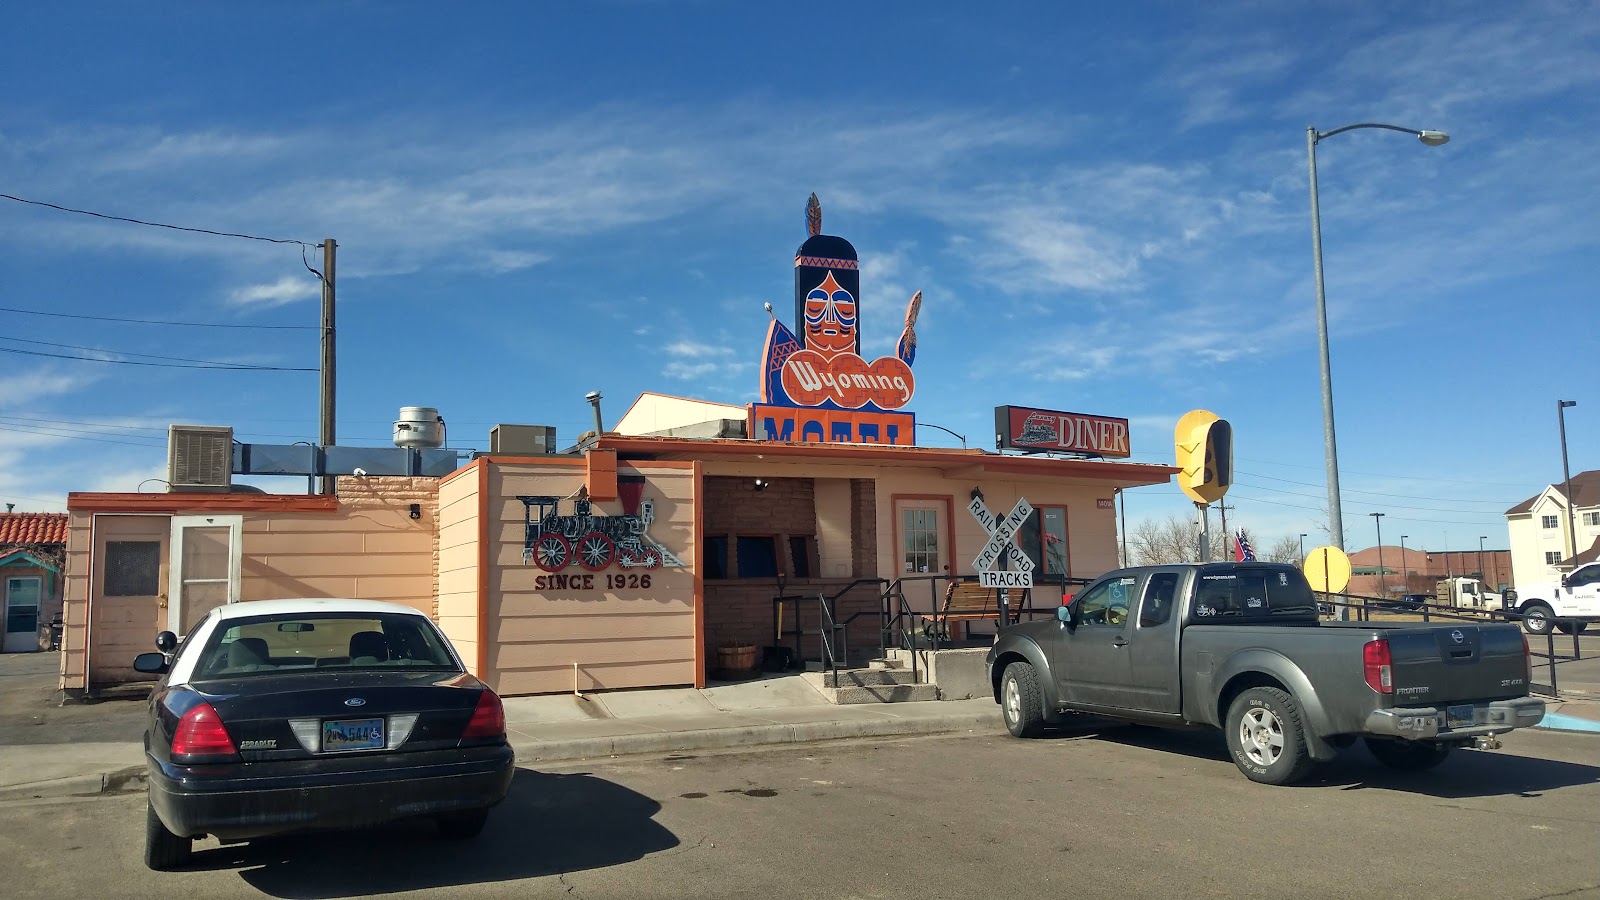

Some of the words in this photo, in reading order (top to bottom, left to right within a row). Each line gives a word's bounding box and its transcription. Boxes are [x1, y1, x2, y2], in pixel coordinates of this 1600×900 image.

[788, 360, 910, 402] Wyoming
[1057, 415, 1128, 453] DINER
[970, 501, 994, 532] RAIL
[978, 505, 1028, 569] CROSSING
[1005, 541, 1031, 572] ROAD
[534, 574, 594, 590] SINCE
[606, 573, 652, 589] 1926
[982, 572, 1030, 586] TRACKS
[1396, 686, 1430, 695] FRONTIER
